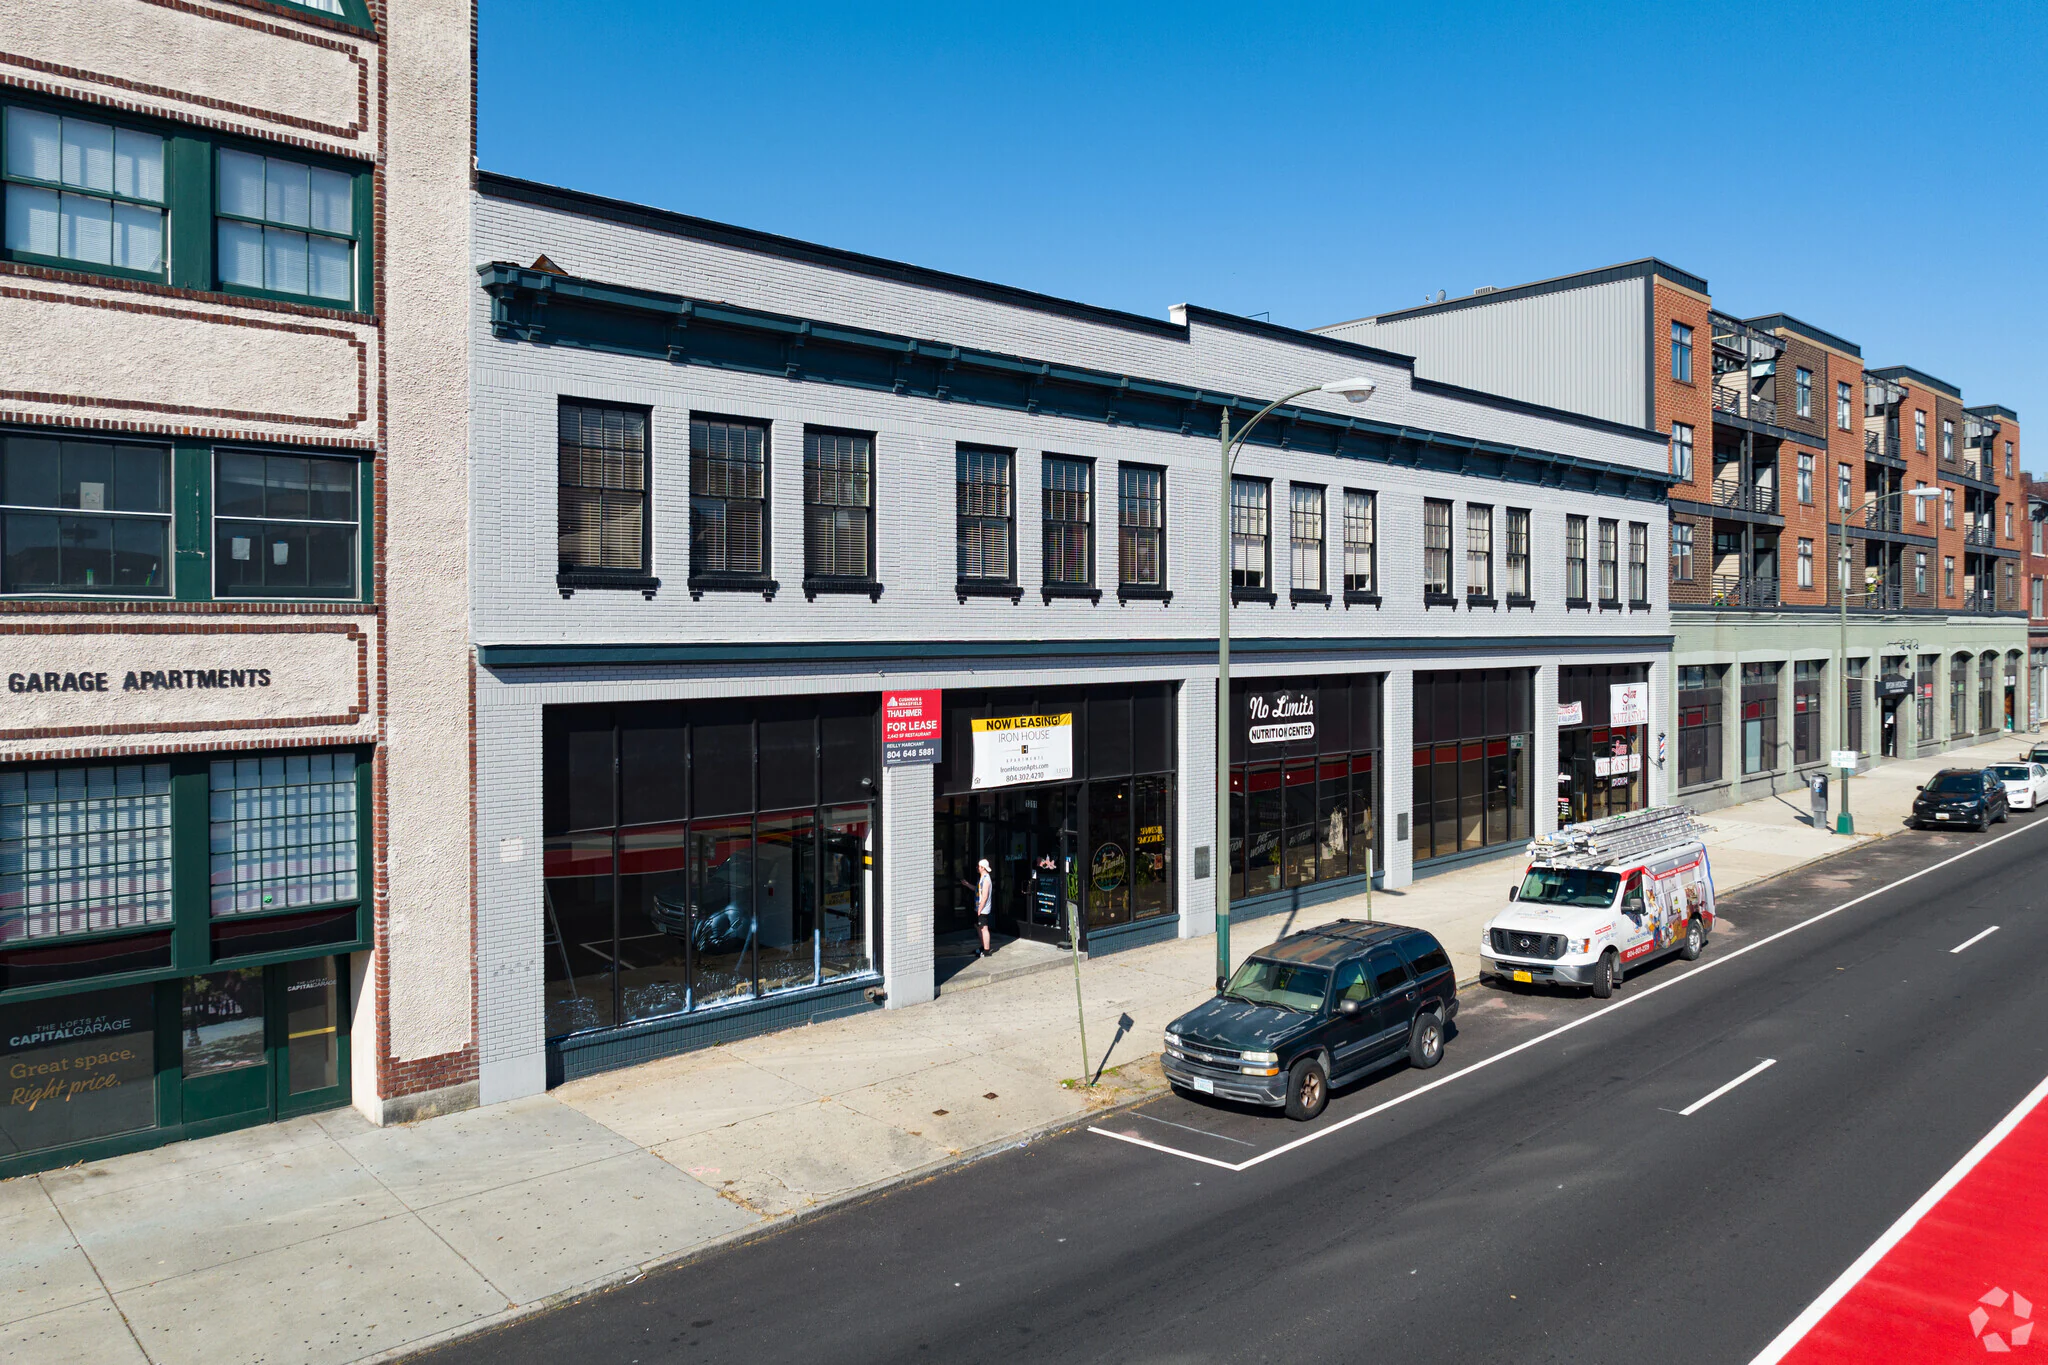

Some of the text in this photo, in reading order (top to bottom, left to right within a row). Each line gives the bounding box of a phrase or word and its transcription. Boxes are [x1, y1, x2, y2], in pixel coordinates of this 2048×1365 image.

[8, 668, 271, 693] GARAGE APARTMENTS
[887, 708, 922, 718] THALHIMER
[1249, 694, 1314, 720] No Limits
[887, 720, 937, 732] FOR LEASE
[986, 715, 1060, 731] NOW LEASING!
[998, 730, 1050, 743] IRON HOUSE
[1251, 725, 1312, 740] NUTRITION CENTER
[887, 748, 934, 759] 804 648 5881
[287, 980, 337, 992] CAPITALGARAGE
[36, 1015, 107, 1032] THE LOFTS AT
[9, 1018, 132, 1047] CAPITALGARAGE
[10, 1049, 136, 1079] Great space.
[10, 1071, 122, 1112] Right price.
